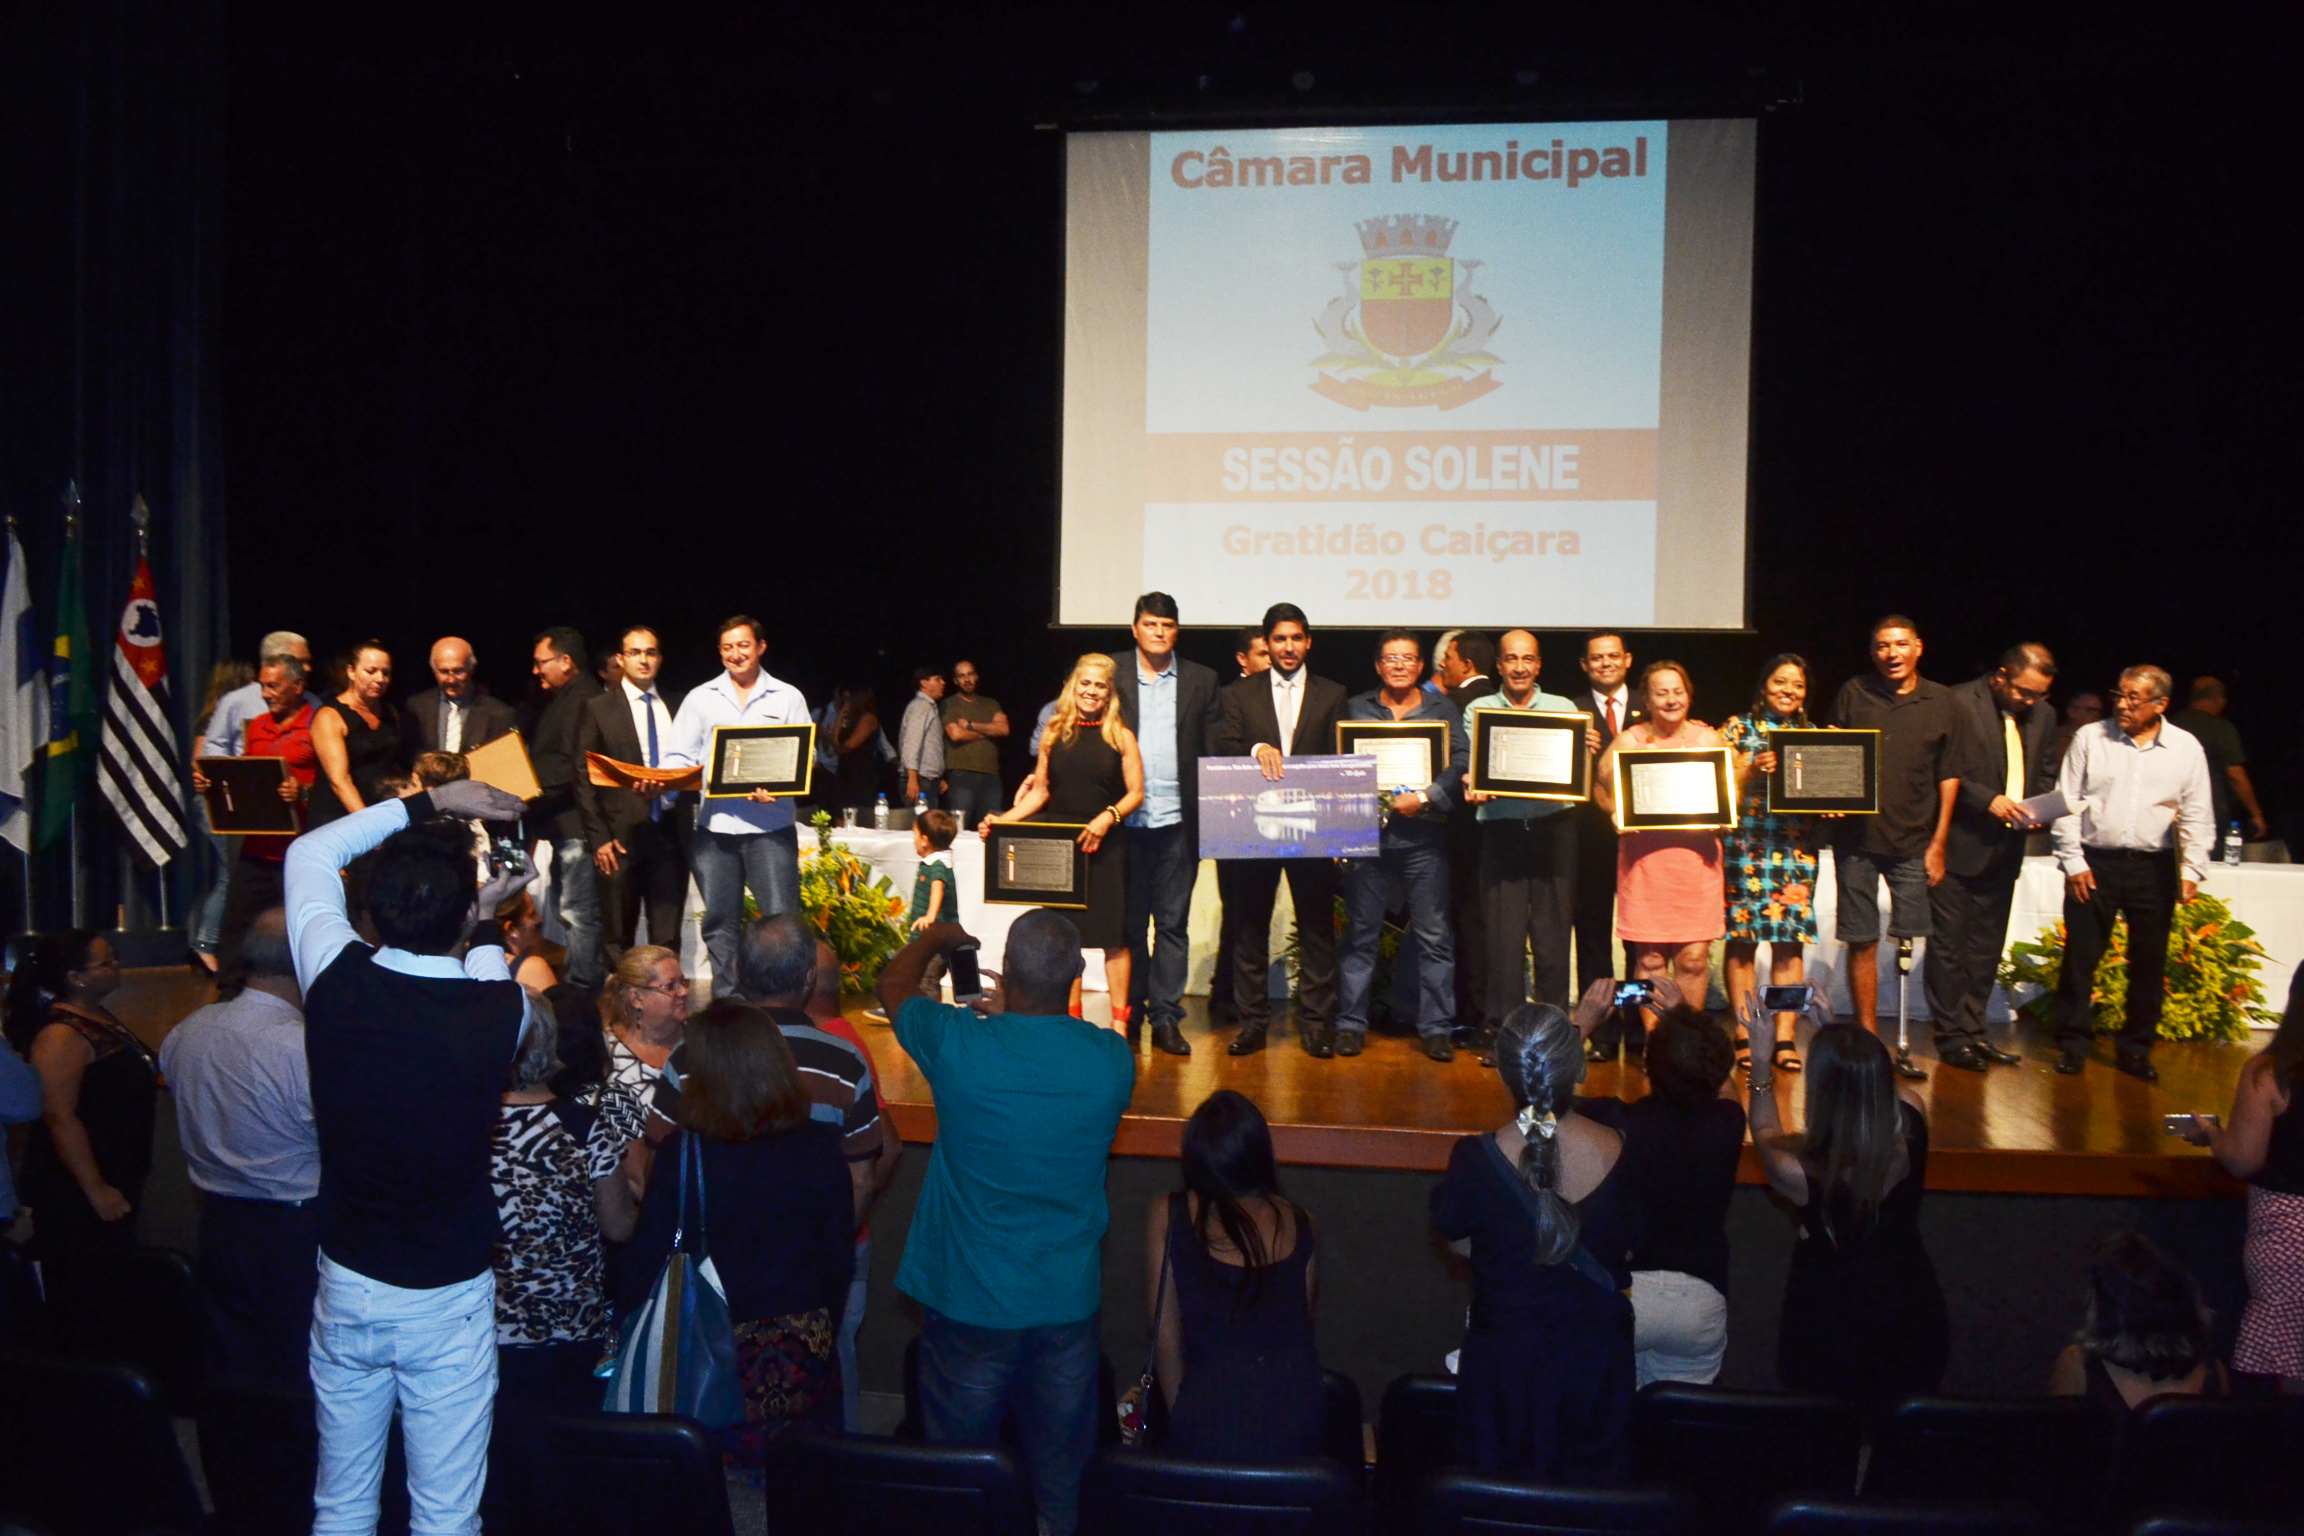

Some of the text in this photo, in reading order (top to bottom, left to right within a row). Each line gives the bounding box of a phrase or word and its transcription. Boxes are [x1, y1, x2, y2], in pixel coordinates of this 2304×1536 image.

[1171, 136, 1647, 188] Câmara Municipal
[1222, 436, 1580, 491] SESSÃO SOLENE
[1222, 522, 1581, 563] Gratidão Caiçara
[1345, 568, 1454, 601] 2018
